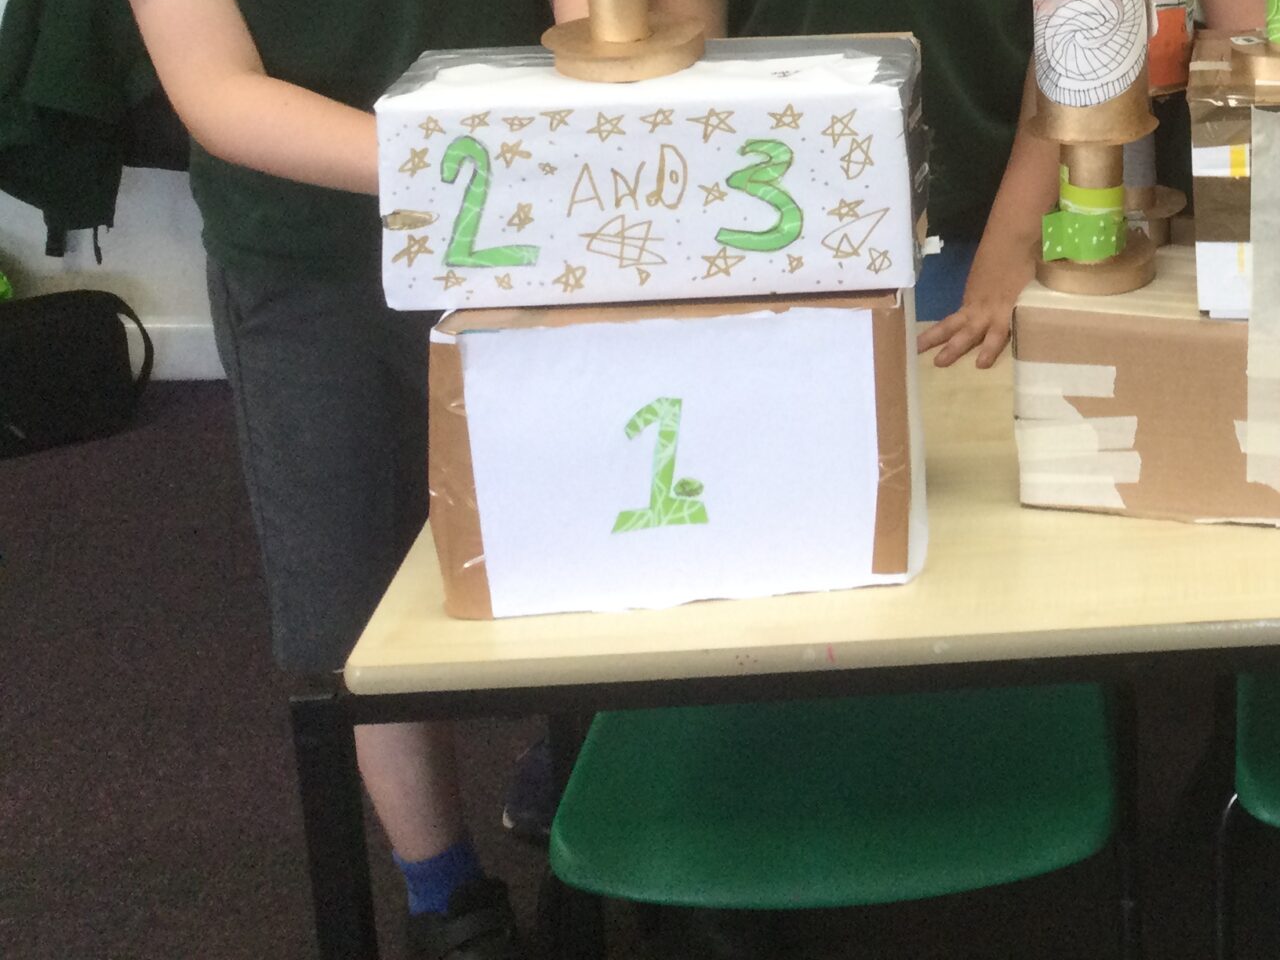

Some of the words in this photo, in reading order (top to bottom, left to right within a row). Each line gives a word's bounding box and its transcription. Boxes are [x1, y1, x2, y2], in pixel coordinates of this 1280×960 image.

[440, 135, 541, 268] 2
[566, 143, 688, 218] AND
[714, 138, 804, 253] 3
